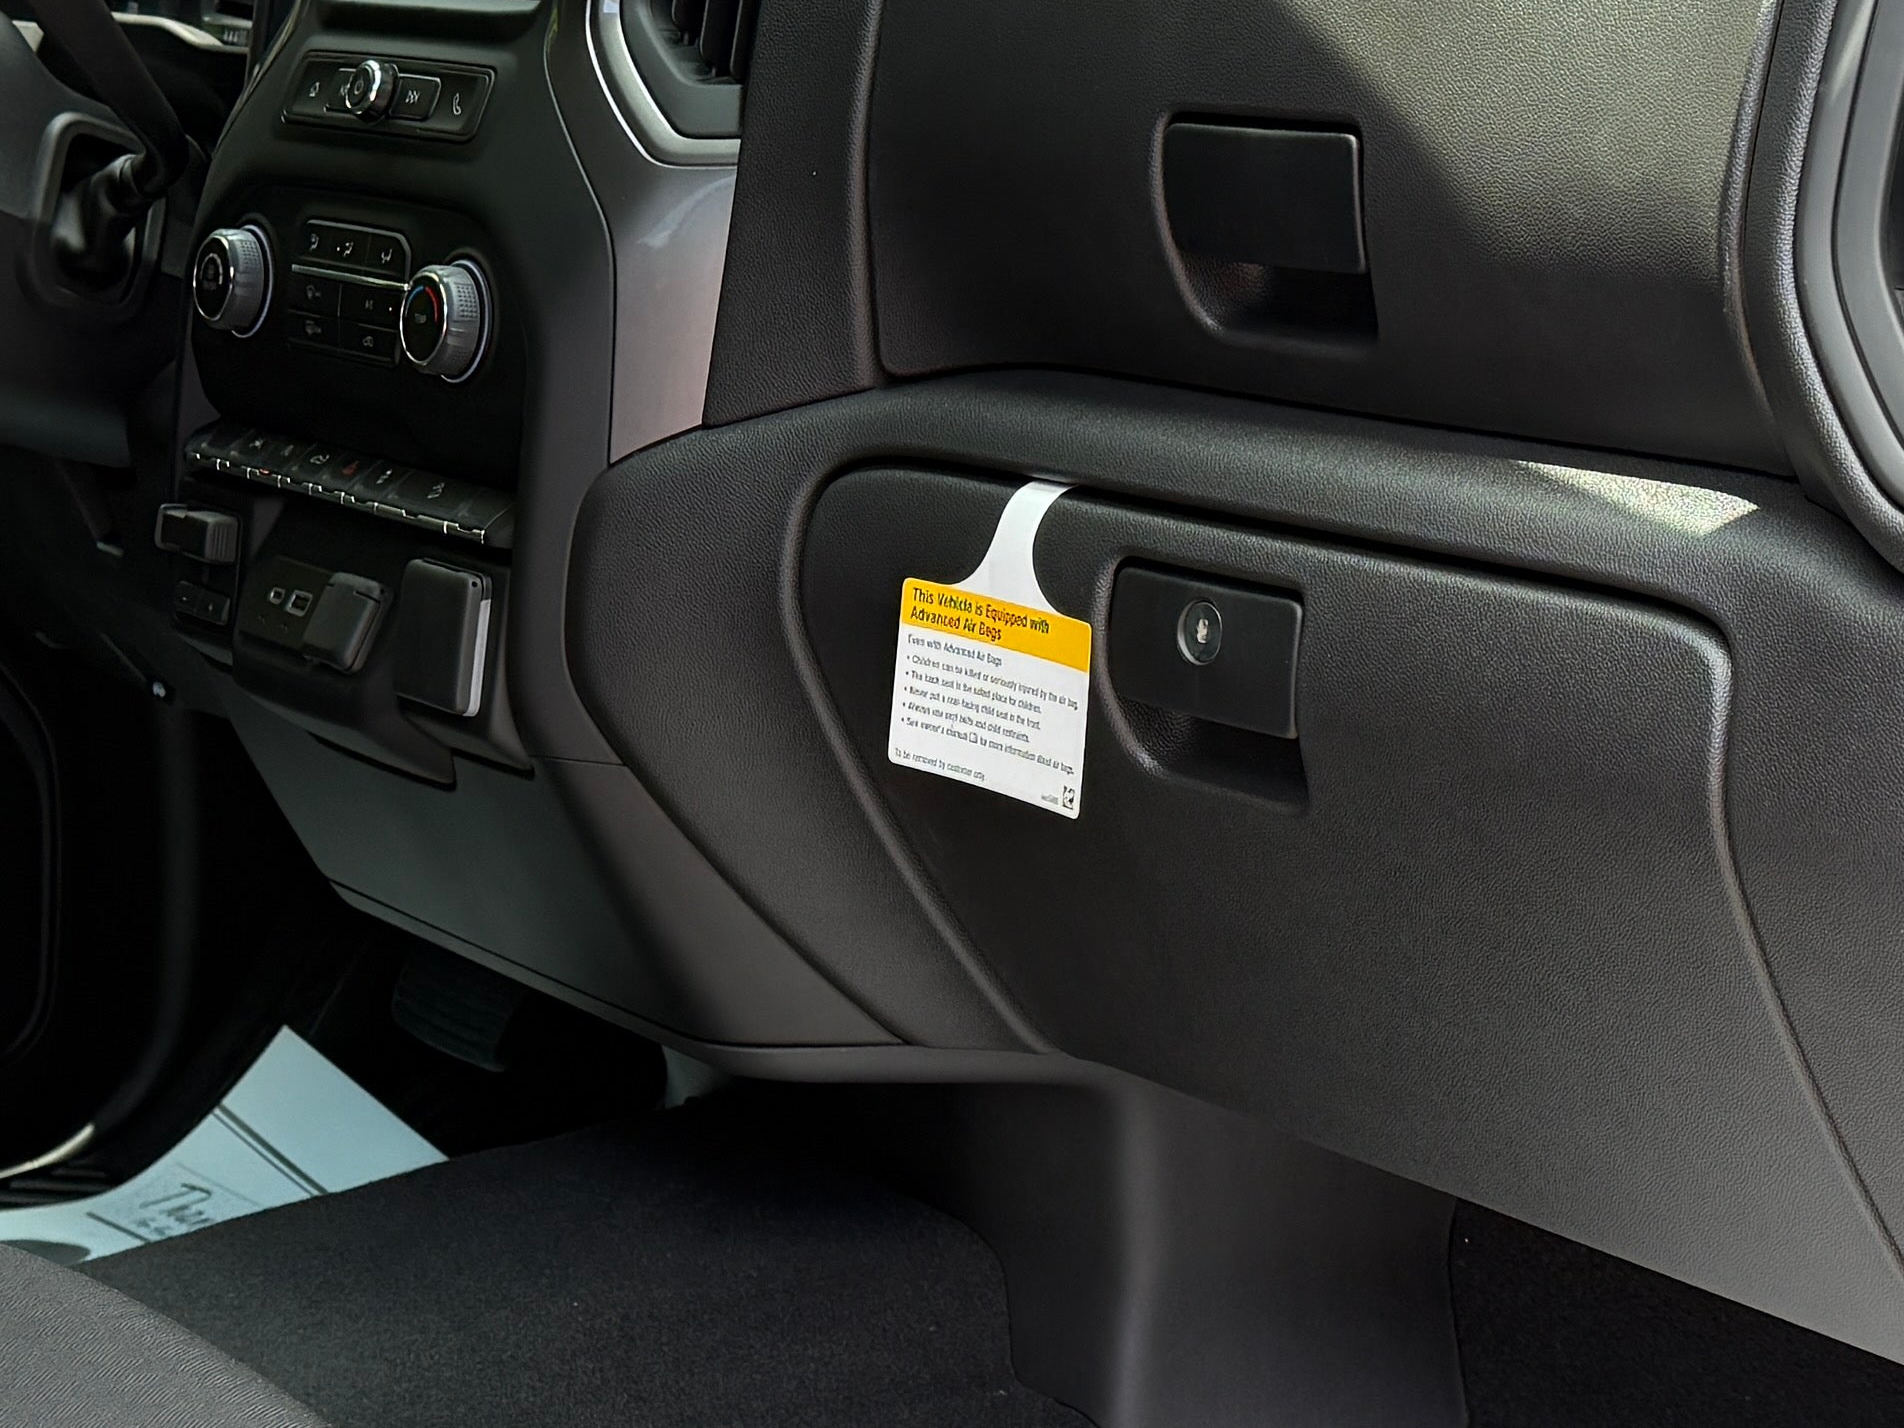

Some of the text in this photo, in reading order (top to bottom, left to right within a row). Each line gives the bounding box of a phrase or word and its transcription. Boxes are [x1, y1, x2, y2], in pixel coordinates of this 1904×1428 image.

[910, 604, 1002, 643] Advanced Air Bags
[912, 586, 1049, 634] This Vehicle is Equipped with
